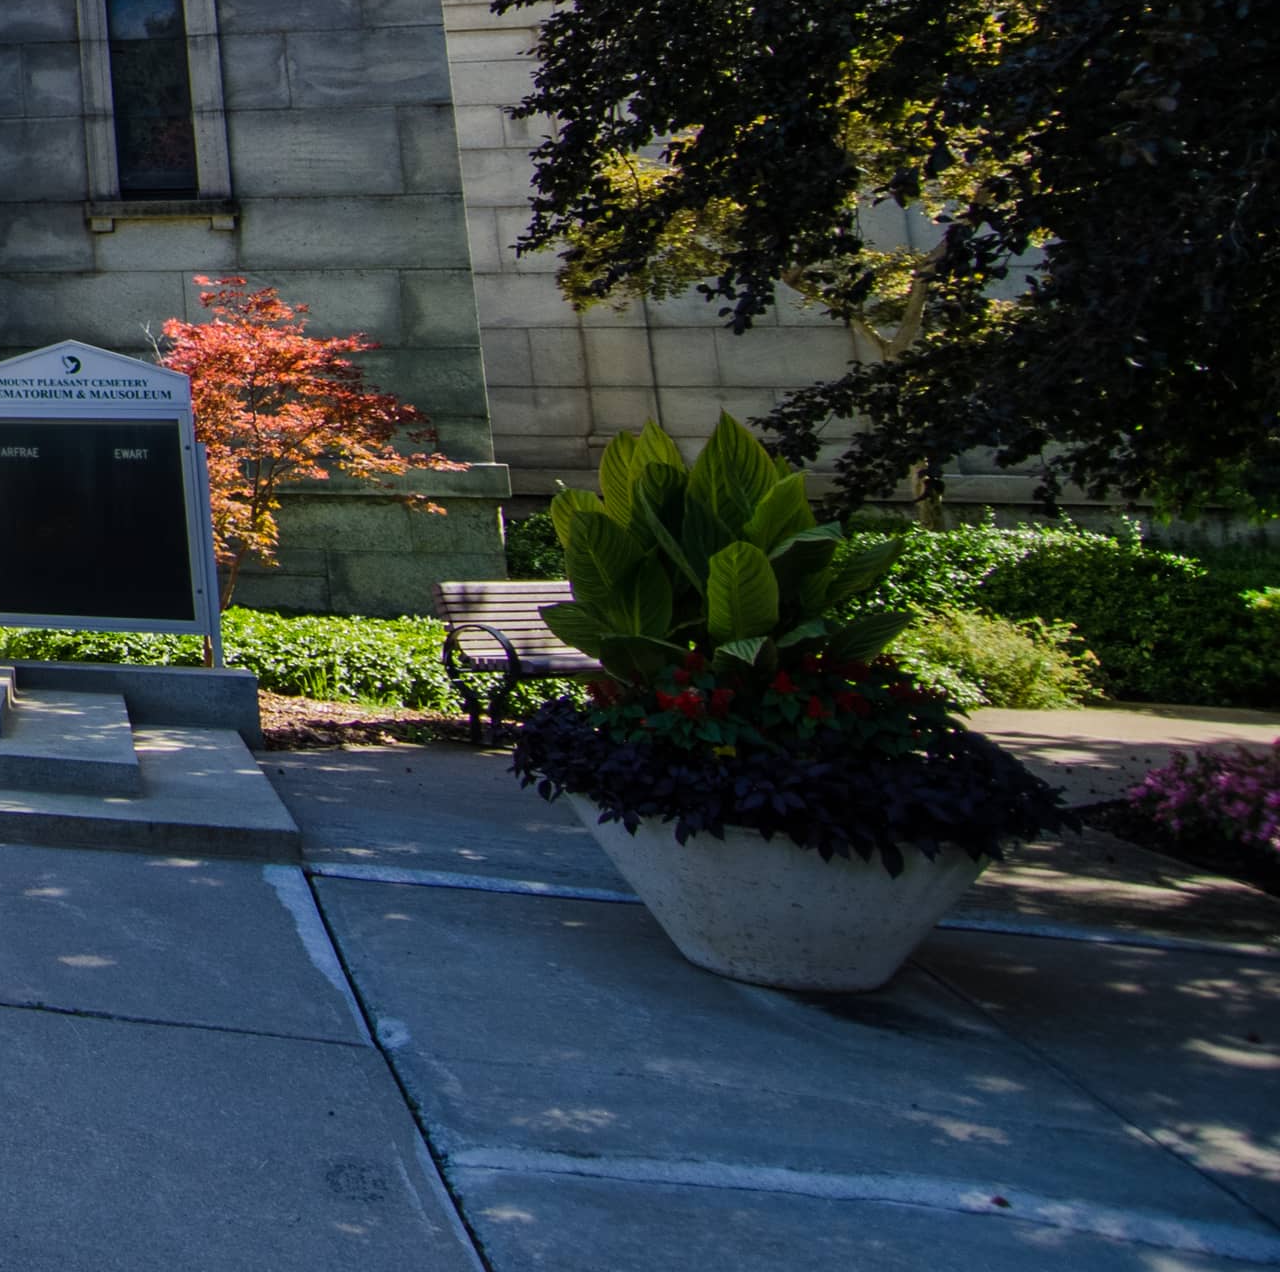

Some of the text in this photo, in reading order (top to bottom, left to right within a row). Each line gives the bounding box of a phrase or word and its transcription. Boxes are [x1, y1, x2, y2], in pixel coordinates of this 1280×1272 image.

[37, 378, 89, 387] PLEASANT
[91, 378, 149, 387] CEMETERY
[76, 390, 86, 399] &
[90, 390, 172, 400] MAUSOLEUM
[113, 448, 150, 459] EWART
